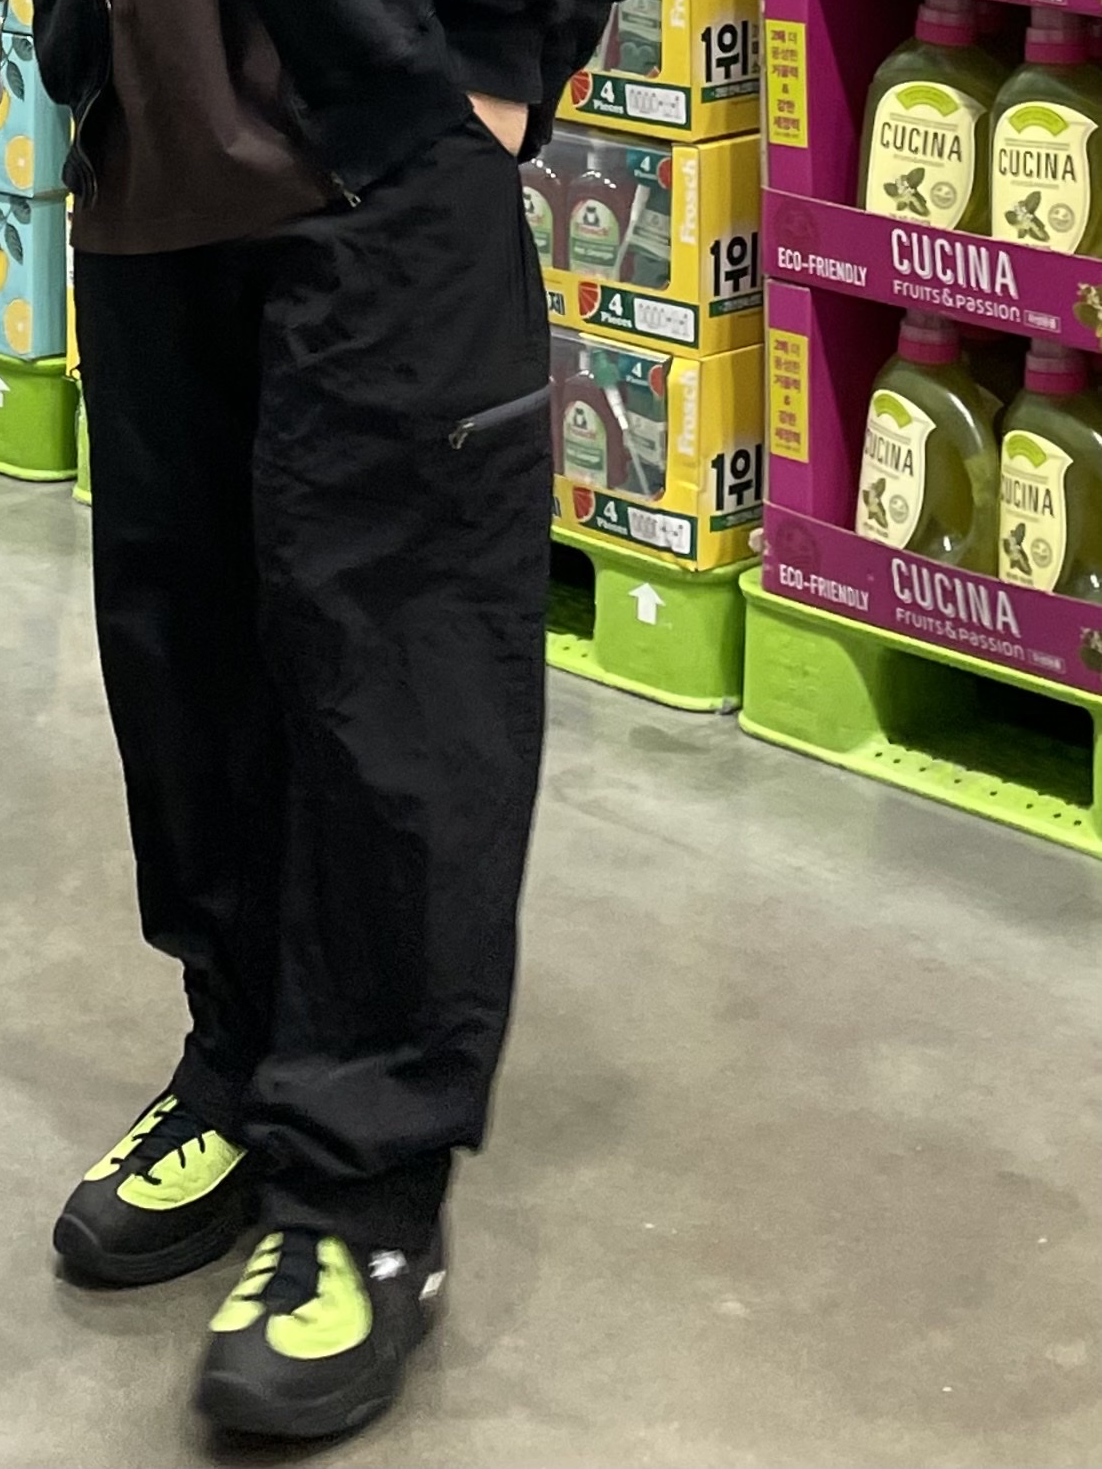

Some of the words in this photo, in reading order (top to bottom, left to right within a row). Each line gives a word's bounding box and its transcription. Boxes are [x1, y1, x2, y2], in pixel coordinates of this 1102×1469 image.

[701, 20, 749, 83] 1위
[600, 80, 614, 103] 4
[879, 121, 963, 163] CUCINA
[998, 148, 1077, 182] CUCINA
[679, 158, 697, 245] Frosch
[709, 232, 758, 298] 1위
[778, 247, 868, 287] ECO-FRIENDLY
[891, 228, 1020, 300] CUCINA
[609, 293, 624, 316] 4
[676, 371, 698, 457] Frosch
[711, 443, 762, 512] 1위
[602, 500, 617, 522] 4
[779, 564, 870, 612] ECO-FRIENDLY
[891, 558, 1022, 638] CUCINA
